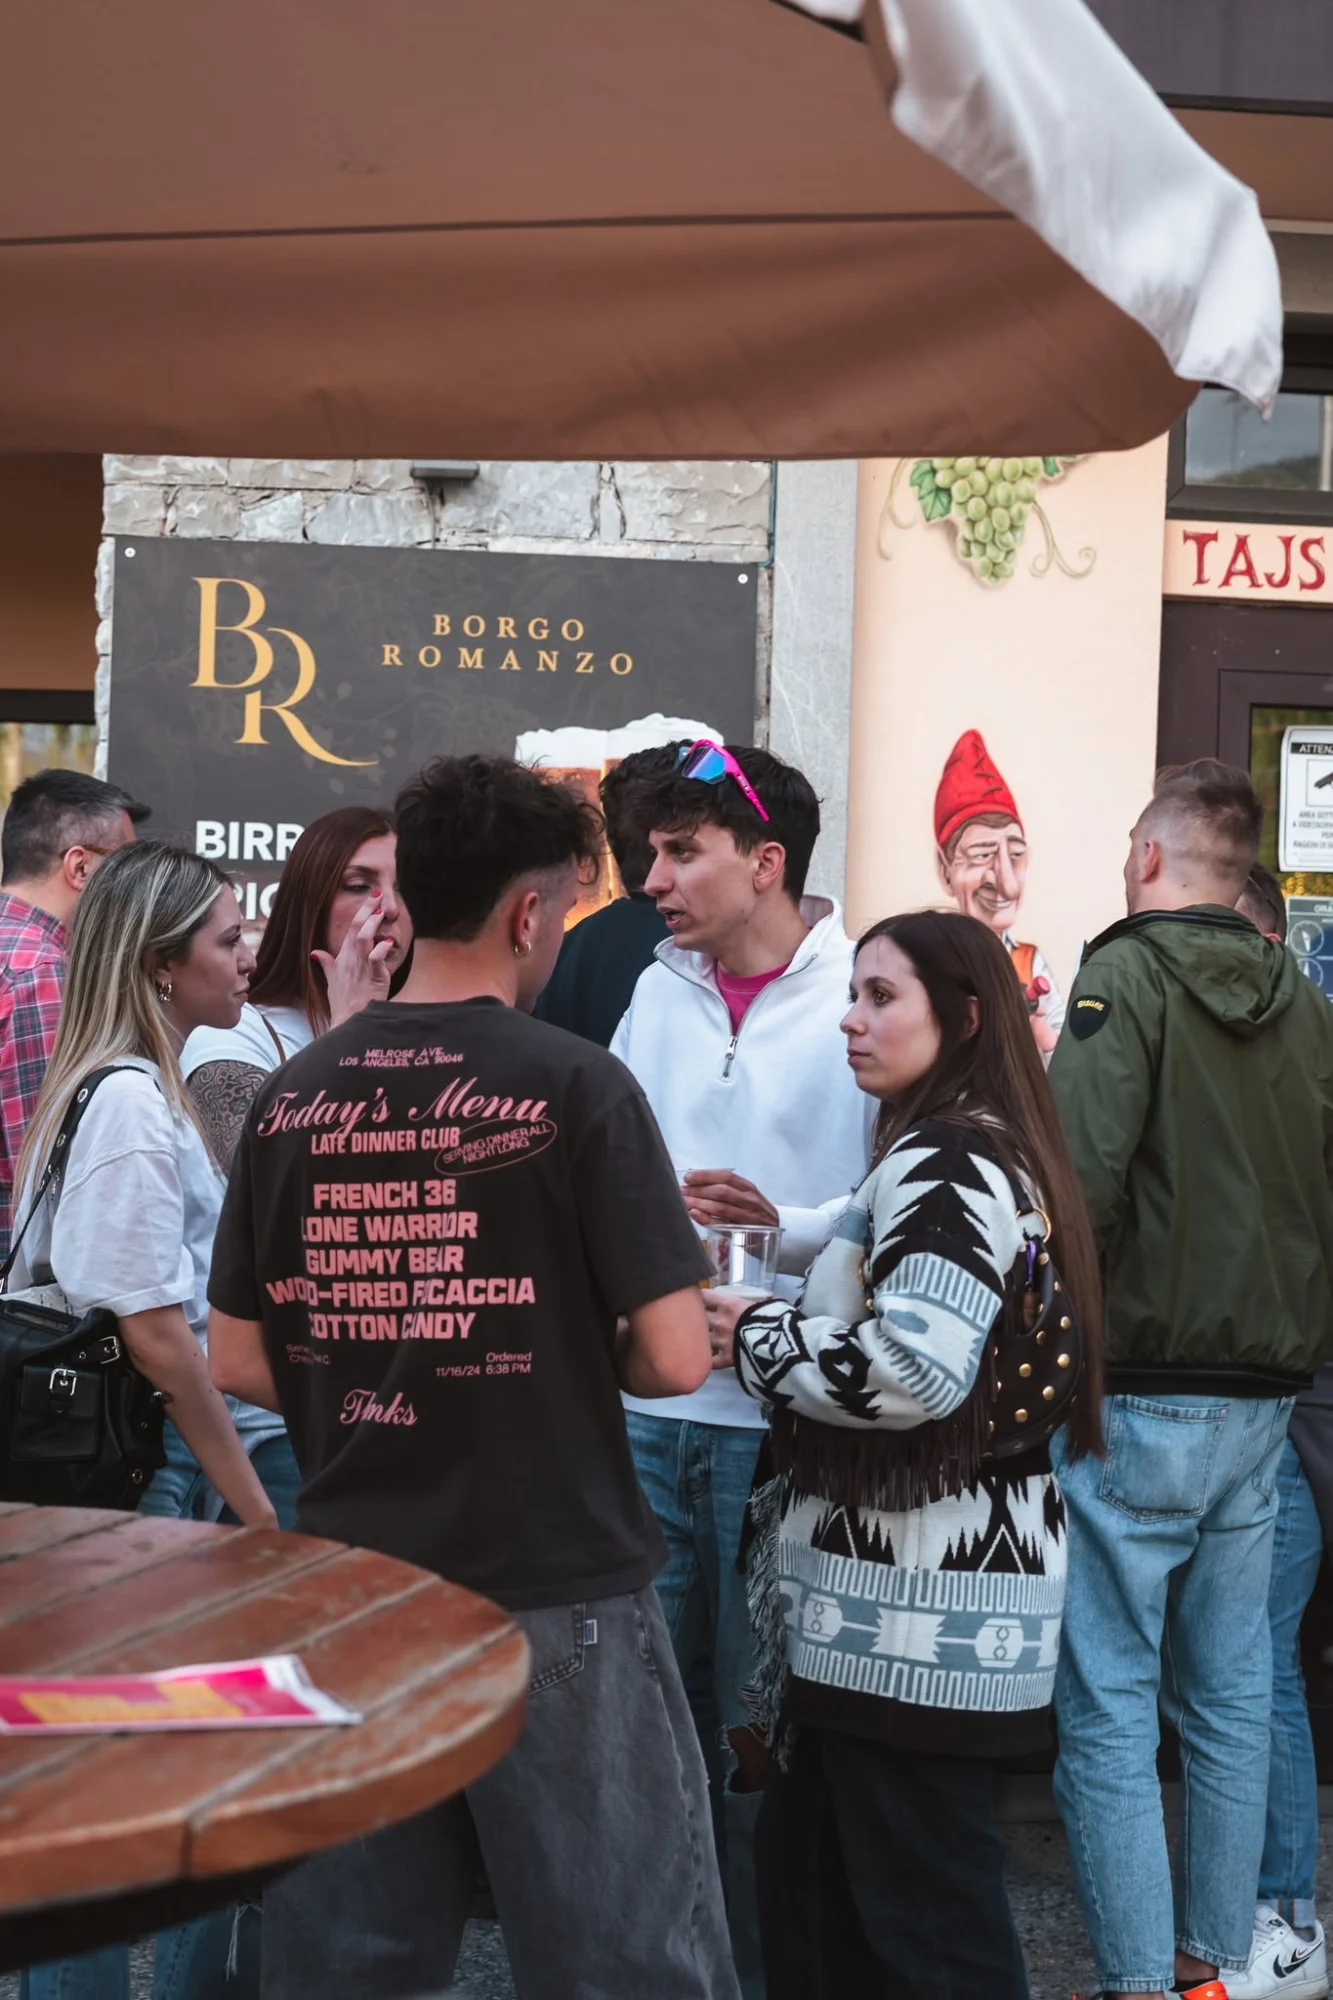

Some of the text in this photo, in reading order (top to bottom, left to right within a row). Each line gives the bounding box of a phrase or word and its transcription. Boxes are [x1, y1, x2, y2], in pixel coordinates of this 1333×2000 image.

[1183, 529, 1325, 592] TAJS
[432, 613, 586, 642] BORGO
[381, 643, 634, 676] ROMANZO
[1299, 743, 1333, 753] ATTEN
[339, 1057, 359, 1066] LOS
[414, 1056, 429, 1066] CA
[365, 1048, 416, 1058] MELROSE
[257, 1077, 549, 1138] Today's Menu
[311, 1127, 461, 1155] LATE DINNER CLUB
[442, 1139, 485, 1164] SERVING
[486, 1128, 529, 1146] DINNER
[463, 1138, 530, 1164] NIGHT LONG
[313, 1181, 418, 1210] FRENCH
[305, 1247, 402, 1275] GUMMY
[486, 1351, 532, 1363] Ordered
[512, 1362, 531, 1374] PM
